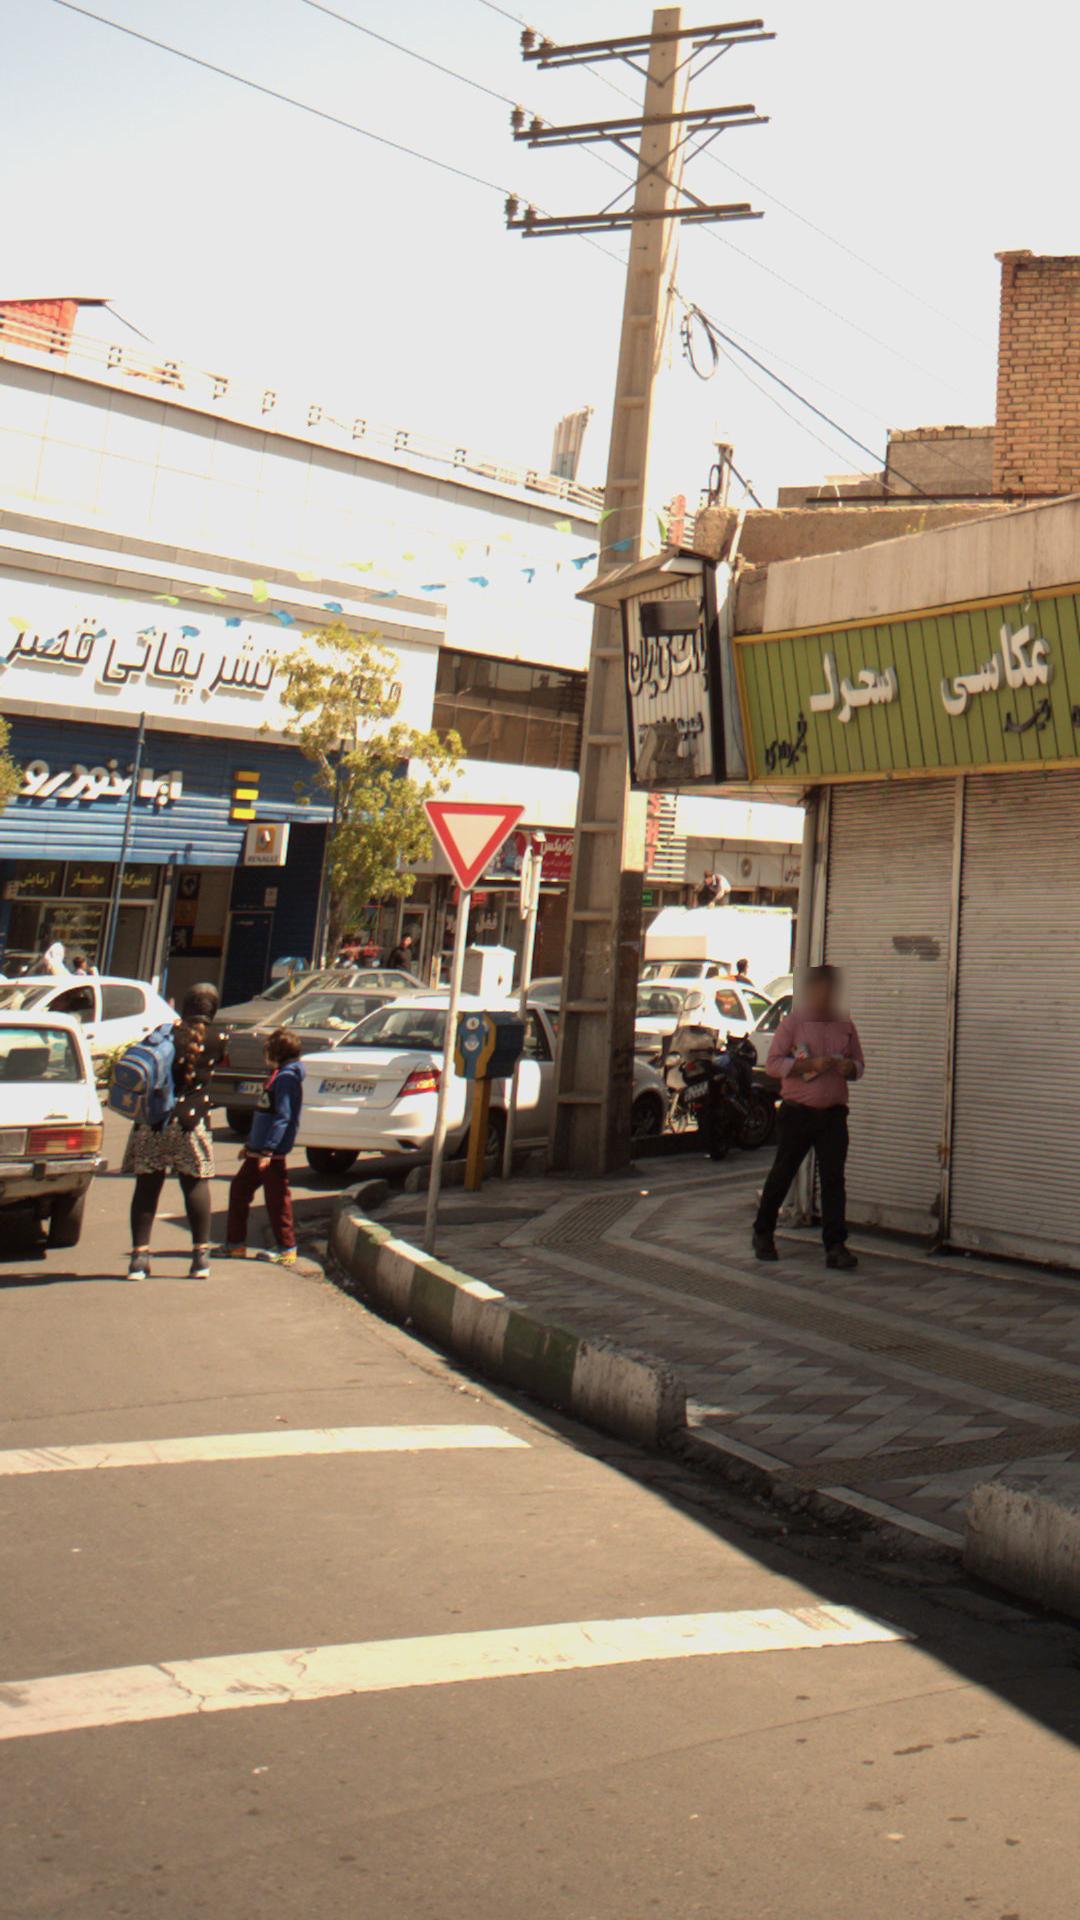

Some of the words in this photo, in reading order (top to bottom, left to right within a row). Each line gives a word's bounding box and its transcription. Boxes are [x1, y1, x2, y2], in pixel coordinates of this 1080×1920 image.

[6, 617, 97, 664] قصر
[102, 628, 278, 697] تشریفاتی
[941, 624, 1052, 716] عکاسی
[69, 871, 105, 889] مجاز
[247, 855, 278, 863] RENAULT
